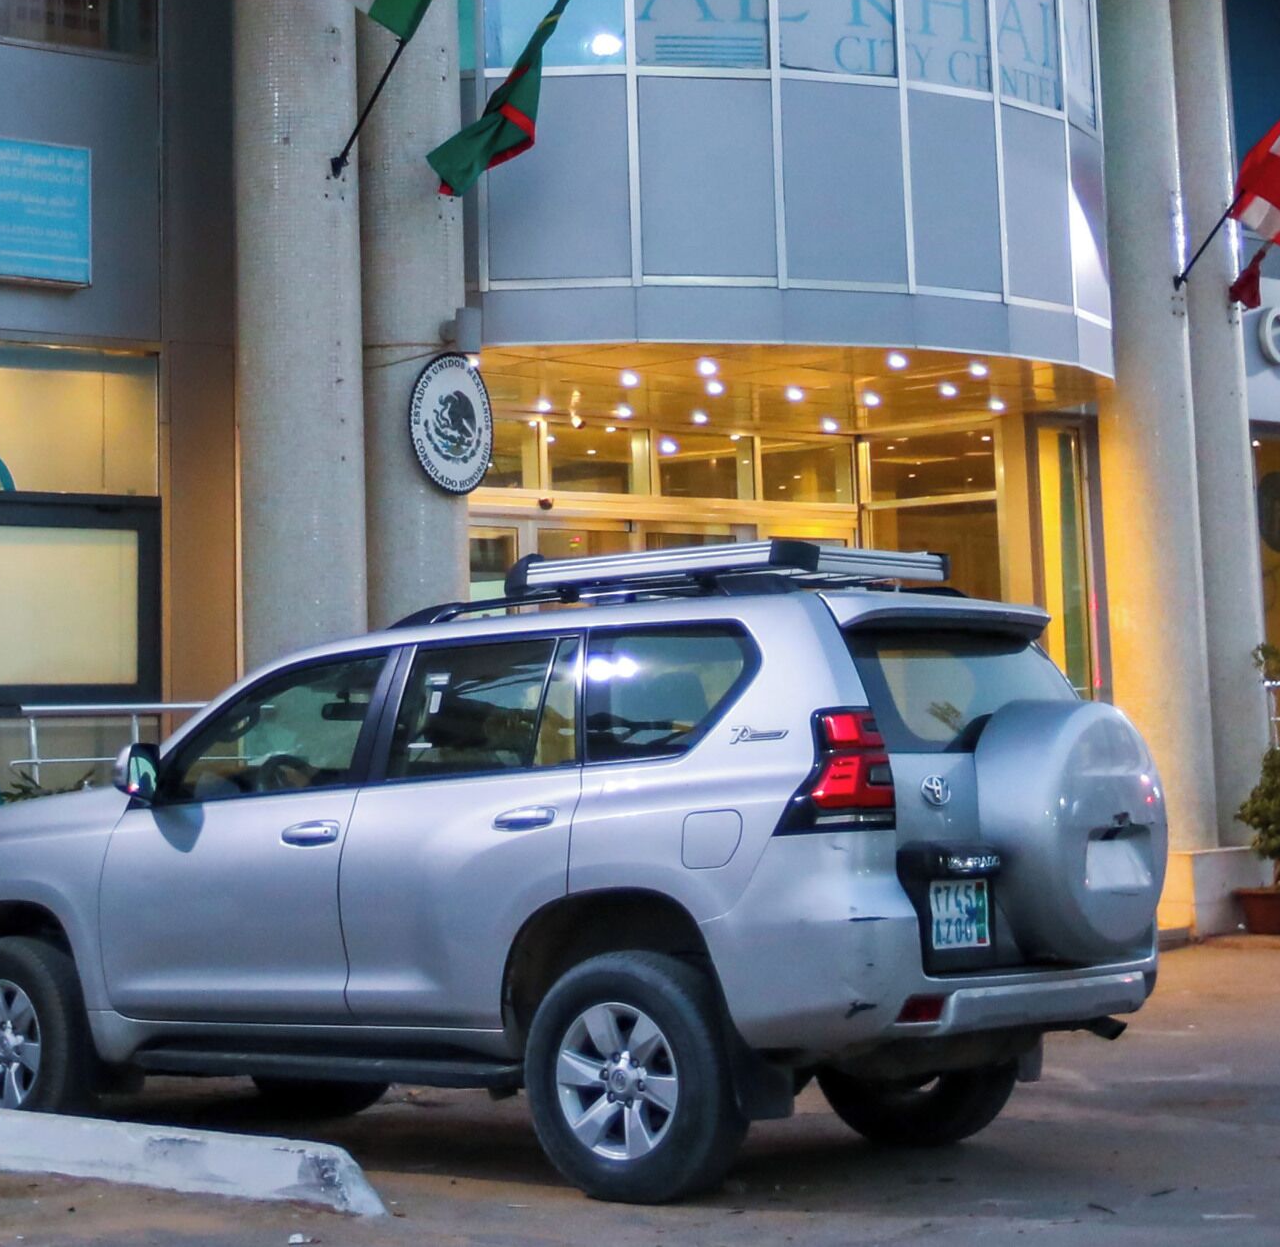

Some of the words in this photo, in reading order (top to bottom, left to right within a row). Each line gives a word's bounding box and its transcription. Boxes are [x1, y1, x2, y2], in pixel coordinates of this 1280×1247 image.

[833, 35, 932, 79] CITY
[413, 374, 433, 426] ESTADOS
[431, 358, 466, 375] UNIDOS
[466, 366, 490, 431] MEXICANOS
[416, 438, 458, 488] CONSULADO
[459, 442, 490, 489] HONORARIO
